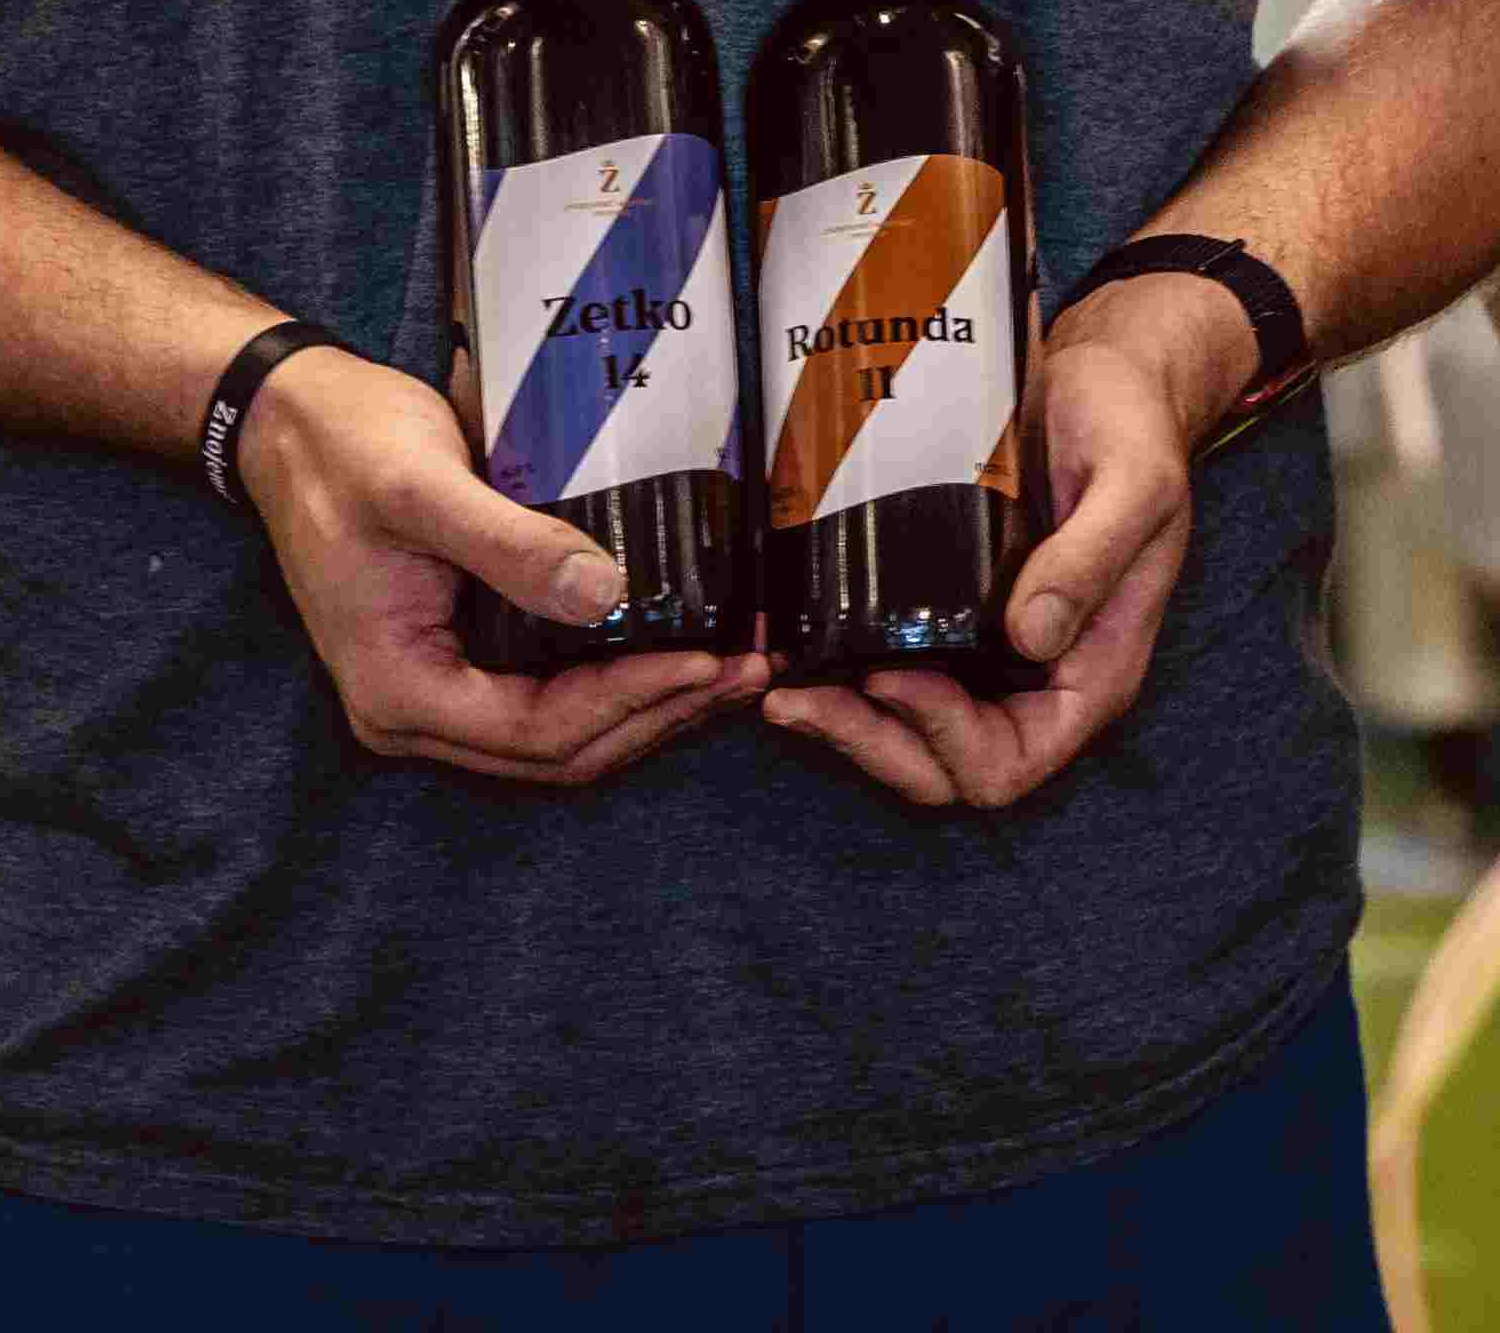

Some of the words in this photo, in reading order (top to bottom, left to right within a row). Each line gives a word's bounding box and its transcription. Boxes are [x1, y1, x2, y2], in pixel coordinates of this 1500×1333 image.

[541, 288, 692, 338] Zetko
[785, 306, 976, 362] Rotunda
[602, 352, 651, 390] 14
[854, 365, 897, 402] 11
